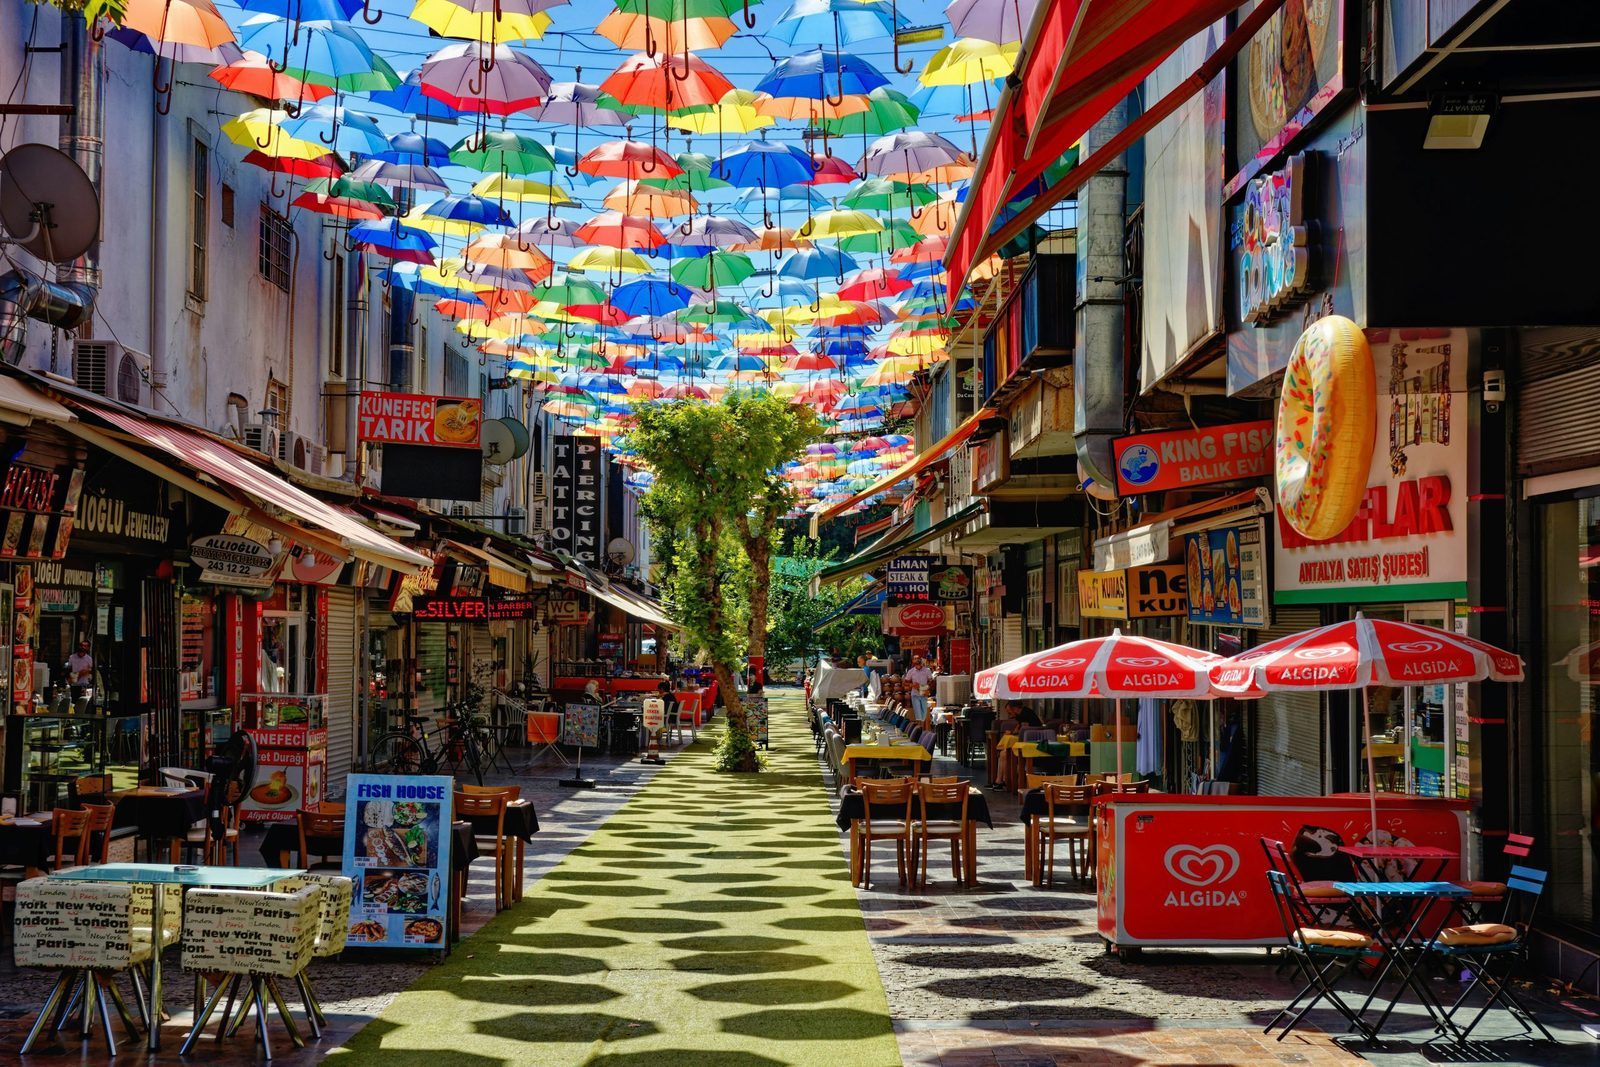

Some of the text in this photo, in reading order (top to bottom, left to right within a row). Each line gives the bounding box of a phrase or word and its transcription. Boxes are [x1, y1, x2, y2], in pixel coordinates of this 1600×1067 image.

[361, 393, 435, 419] KÜNEFECİ
[361, 416, 431, 442] TARIK
[1161, 435, 1216, 464] KING
[1180, 461, 1232, 482] BALIK
[552, 444, 571, 558] TATTOO
[576, 444, 597, 561] PIERCING
[125, 511, 170, 544] JEWELLERY
[208, 561, 250, 575] 243 12 22
[1300, 547, 1428, 584] ANTALYA SATIŞ ŞUBESİ
[890, 573, 923, 581] STEAK &
[940, 590, 967, 598] PIZZA
[427, 602, 486, 618] SILVER
[497, 602, 532, 610] BARBER
[551, 602, 575, 613] WC
[902, 610, 942, 620] Anis
[251, 731, 305, 745] ÜNEFECİ
[274, 751, 304, 765] Durağı
[358, 784, 445, 799] FISH HOUSE
[20, 901, 116, 912] York New York
[186, 905, 223, 915] Paris
[254, 908, 290, 919] Paris
[15, 917, 129, 929] ondon London
[202, 929, 297, 943] New York New
[36, 939, 75, 949] Paris
[220, 945, 273, 957] London
